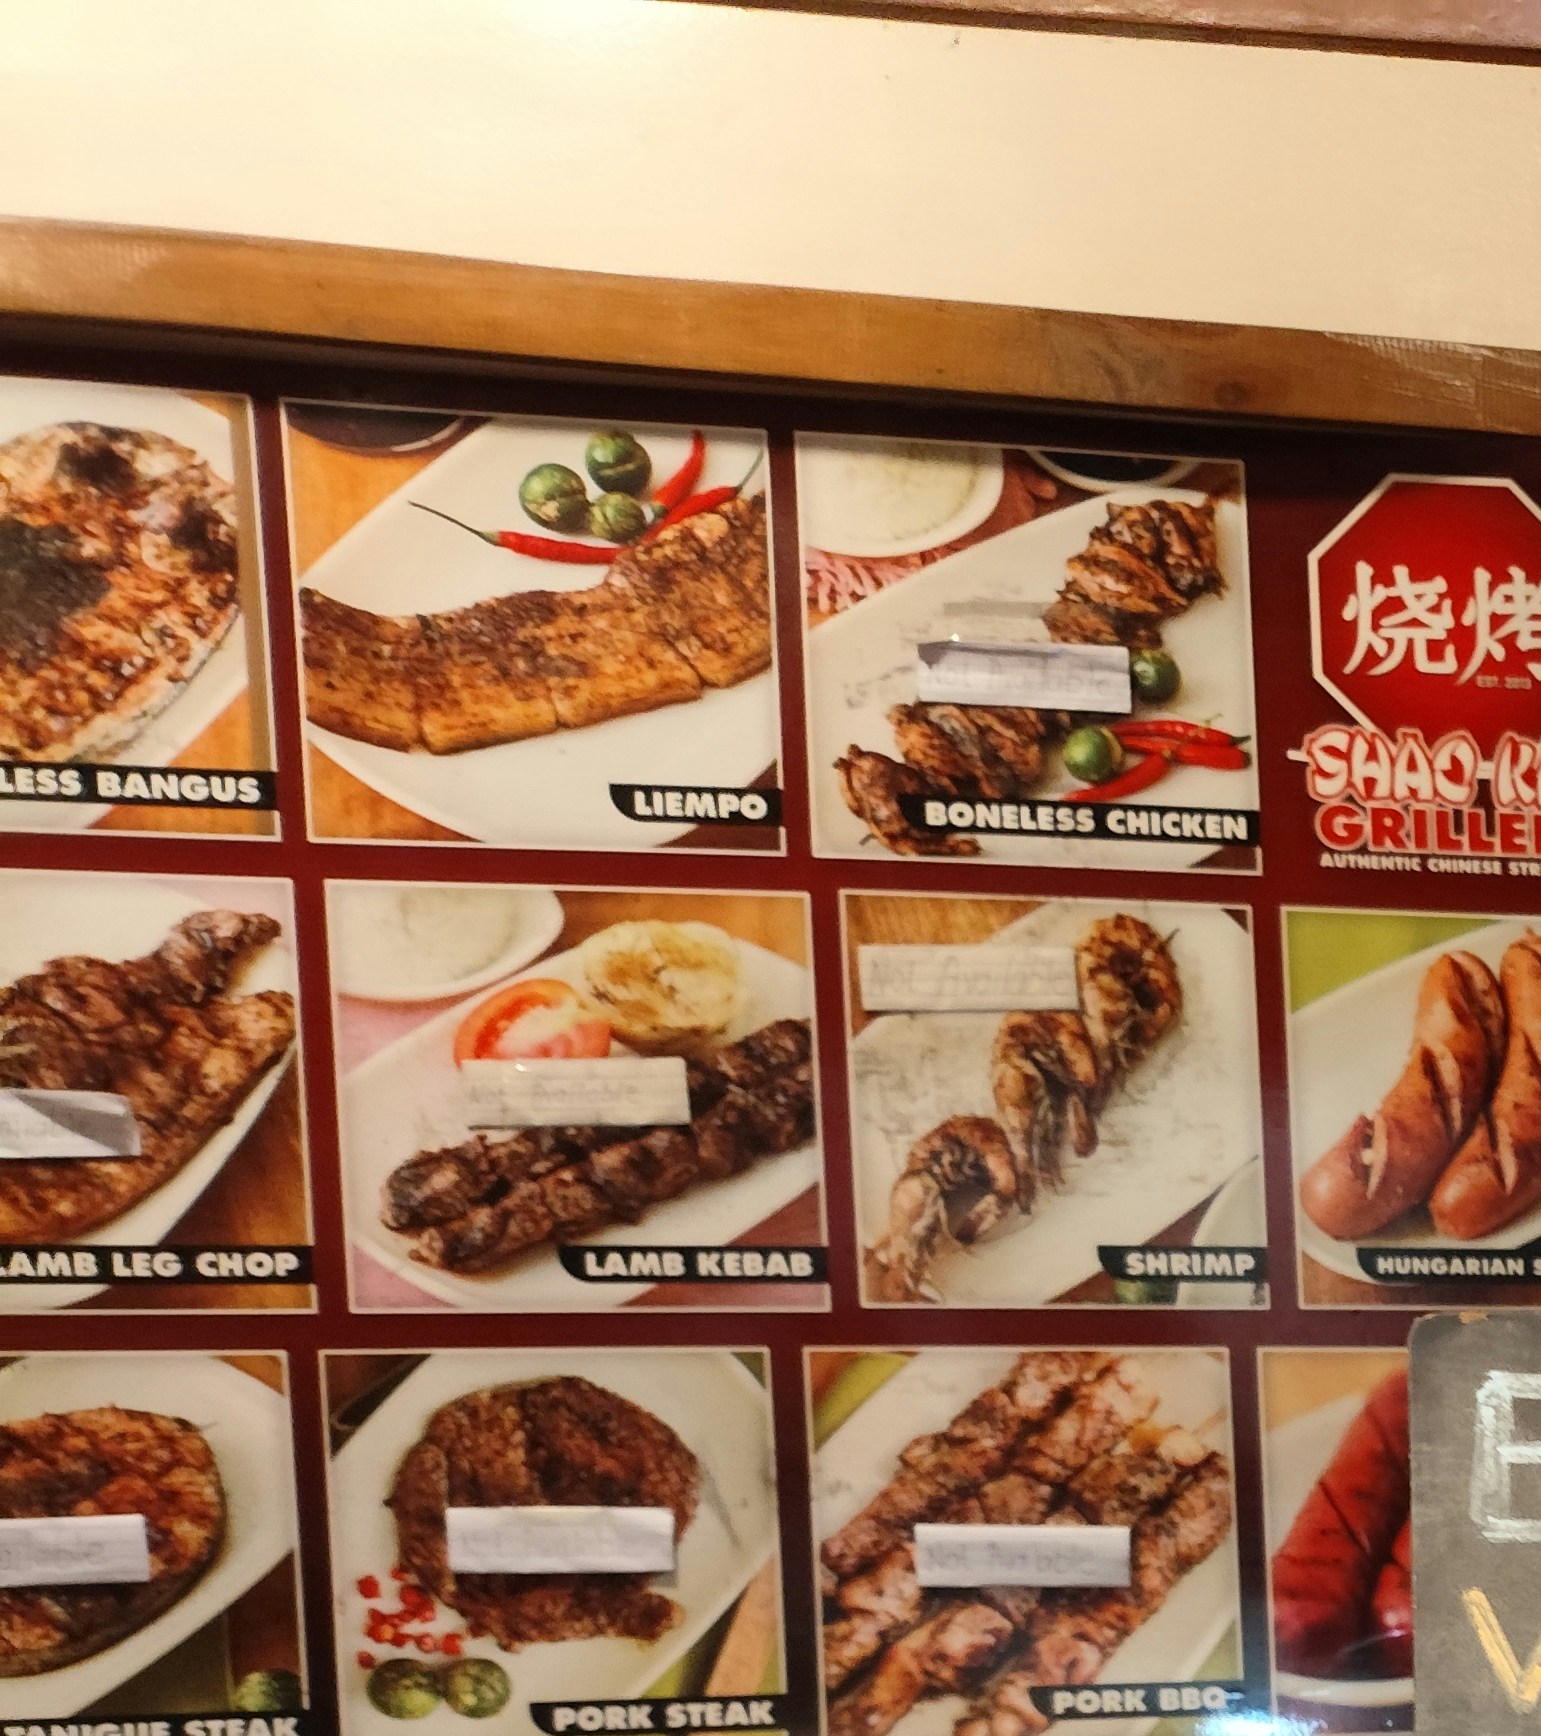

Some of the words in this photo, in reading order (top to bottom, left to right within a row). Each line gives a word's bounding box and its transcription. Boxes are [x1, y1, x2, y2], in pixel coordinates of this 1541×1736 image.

[96, 771, 262, 804] BANGUS
[633, 790, 769, 822] LIEMPO
[924, 800, 1095, 834] BONELESS
[1106, 808, 1249, 841] CHICKEN
[1319, 852, 1422, 873] AUTHENTIC
[1427, 857, 1502, 875] CHINESE
[0, 1251, 98, 1278] AMB
[112, 1251, 184, 1278] LEG
[195, 1251, 300, 1279] CHOP
[584, 1250, 686, 1278] LAMB
[697, 1251, 814, 1279] KEBAB
[1124, 1252, 1257, 1277] SHRIMP
[1376, 1255, 1525, 1277] HUNGARIAN
[1051, 1689, 1147, 1715] PORK
[1157, 1685, 1232, 1713] BBQ
[552, 1704, 654, 1733] PORK
[664, 1700, 776, 1729] STEAK
